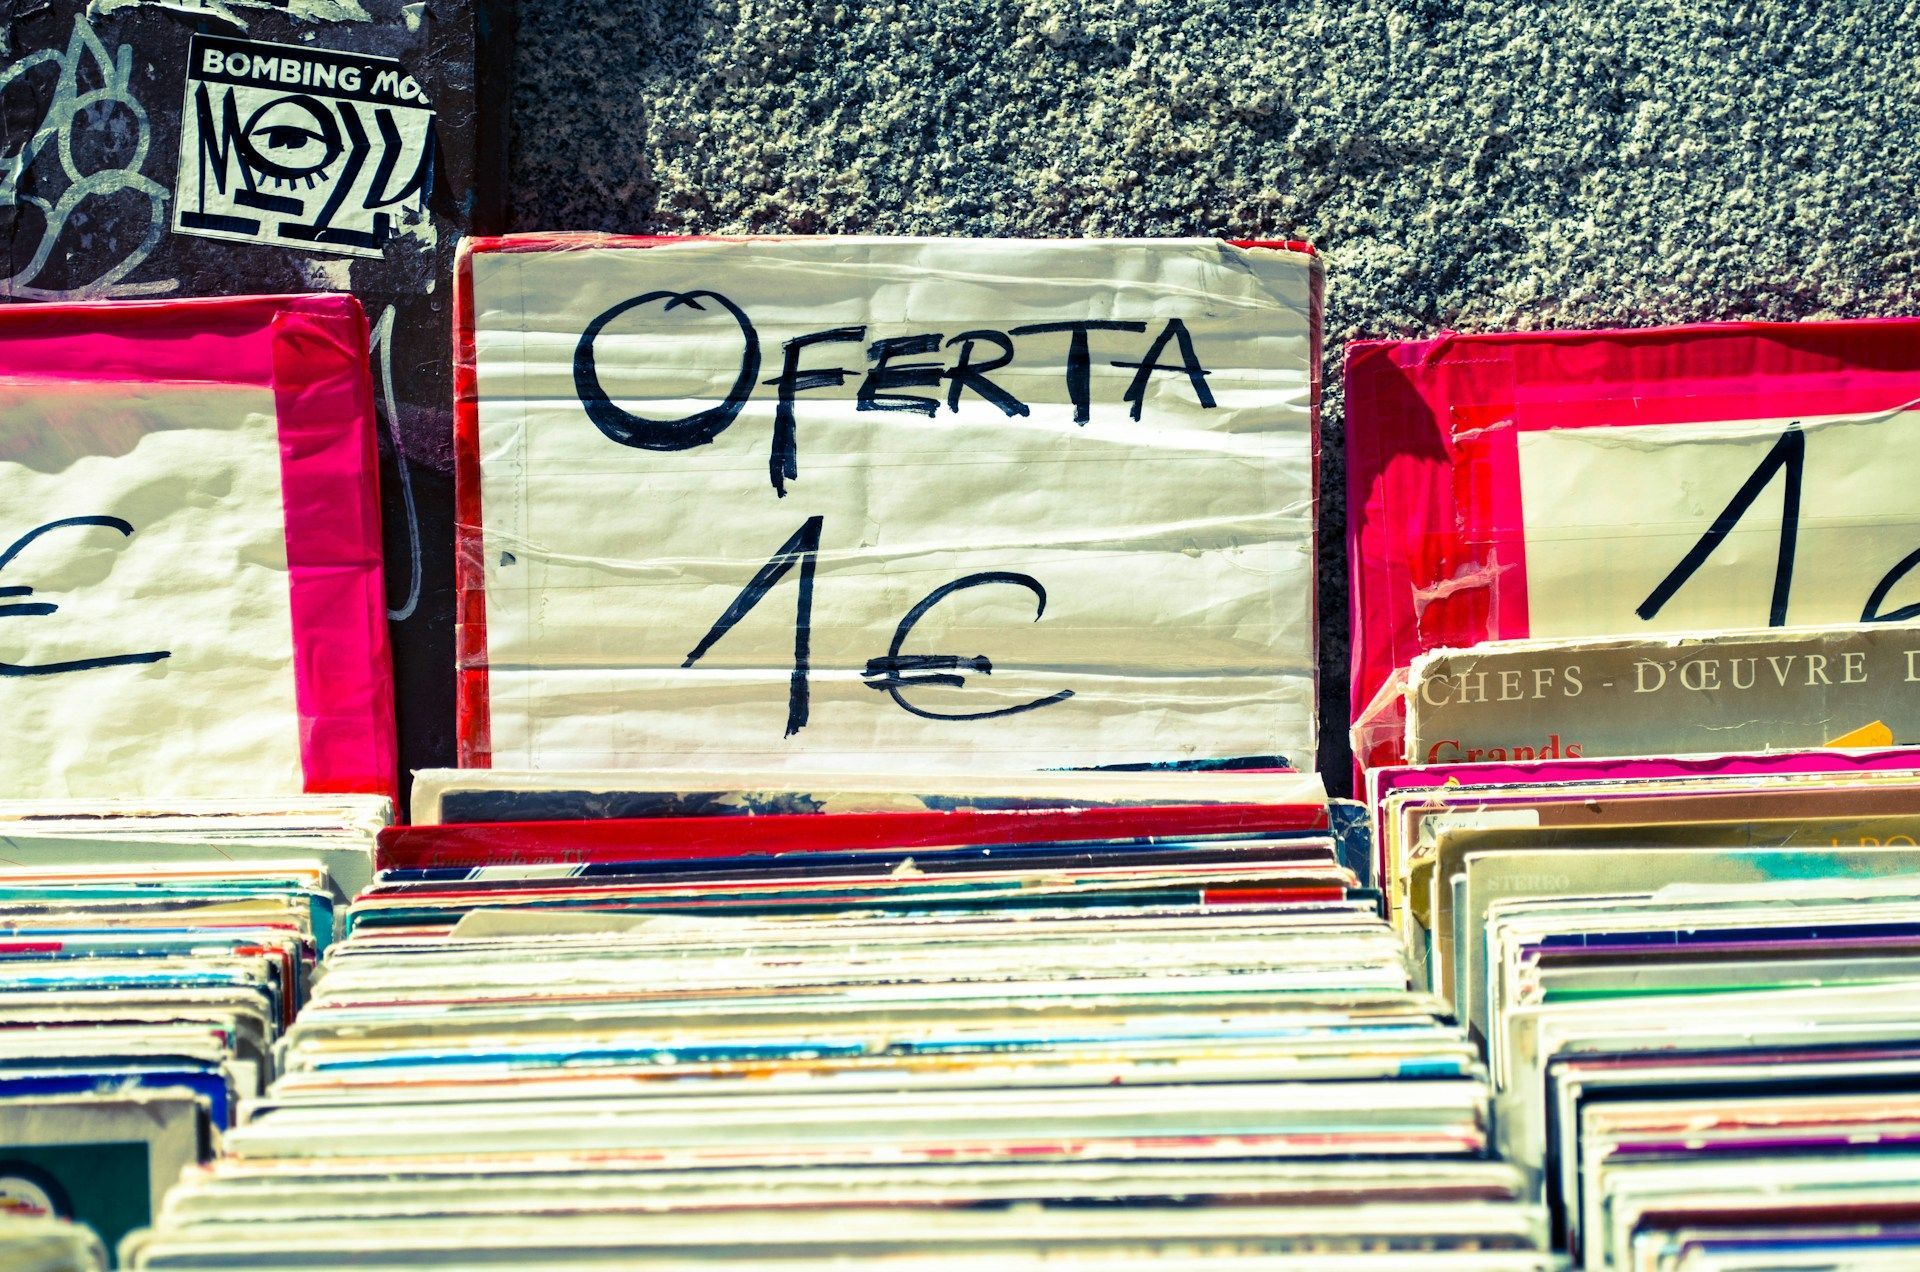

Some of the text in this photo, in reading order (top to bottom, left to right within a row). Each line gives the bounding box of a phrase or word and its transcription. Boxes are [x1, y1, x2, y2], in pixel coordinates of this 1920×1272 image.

[202, 48, 430, 105] BOMBING MO
[573, 290, 1216, 498] OFERTA
[1421, 664, 1584, 707] CHEFS
[1427, 733, 1584, 764] Grands
[1487, 874, 1571, 892] STEREO
